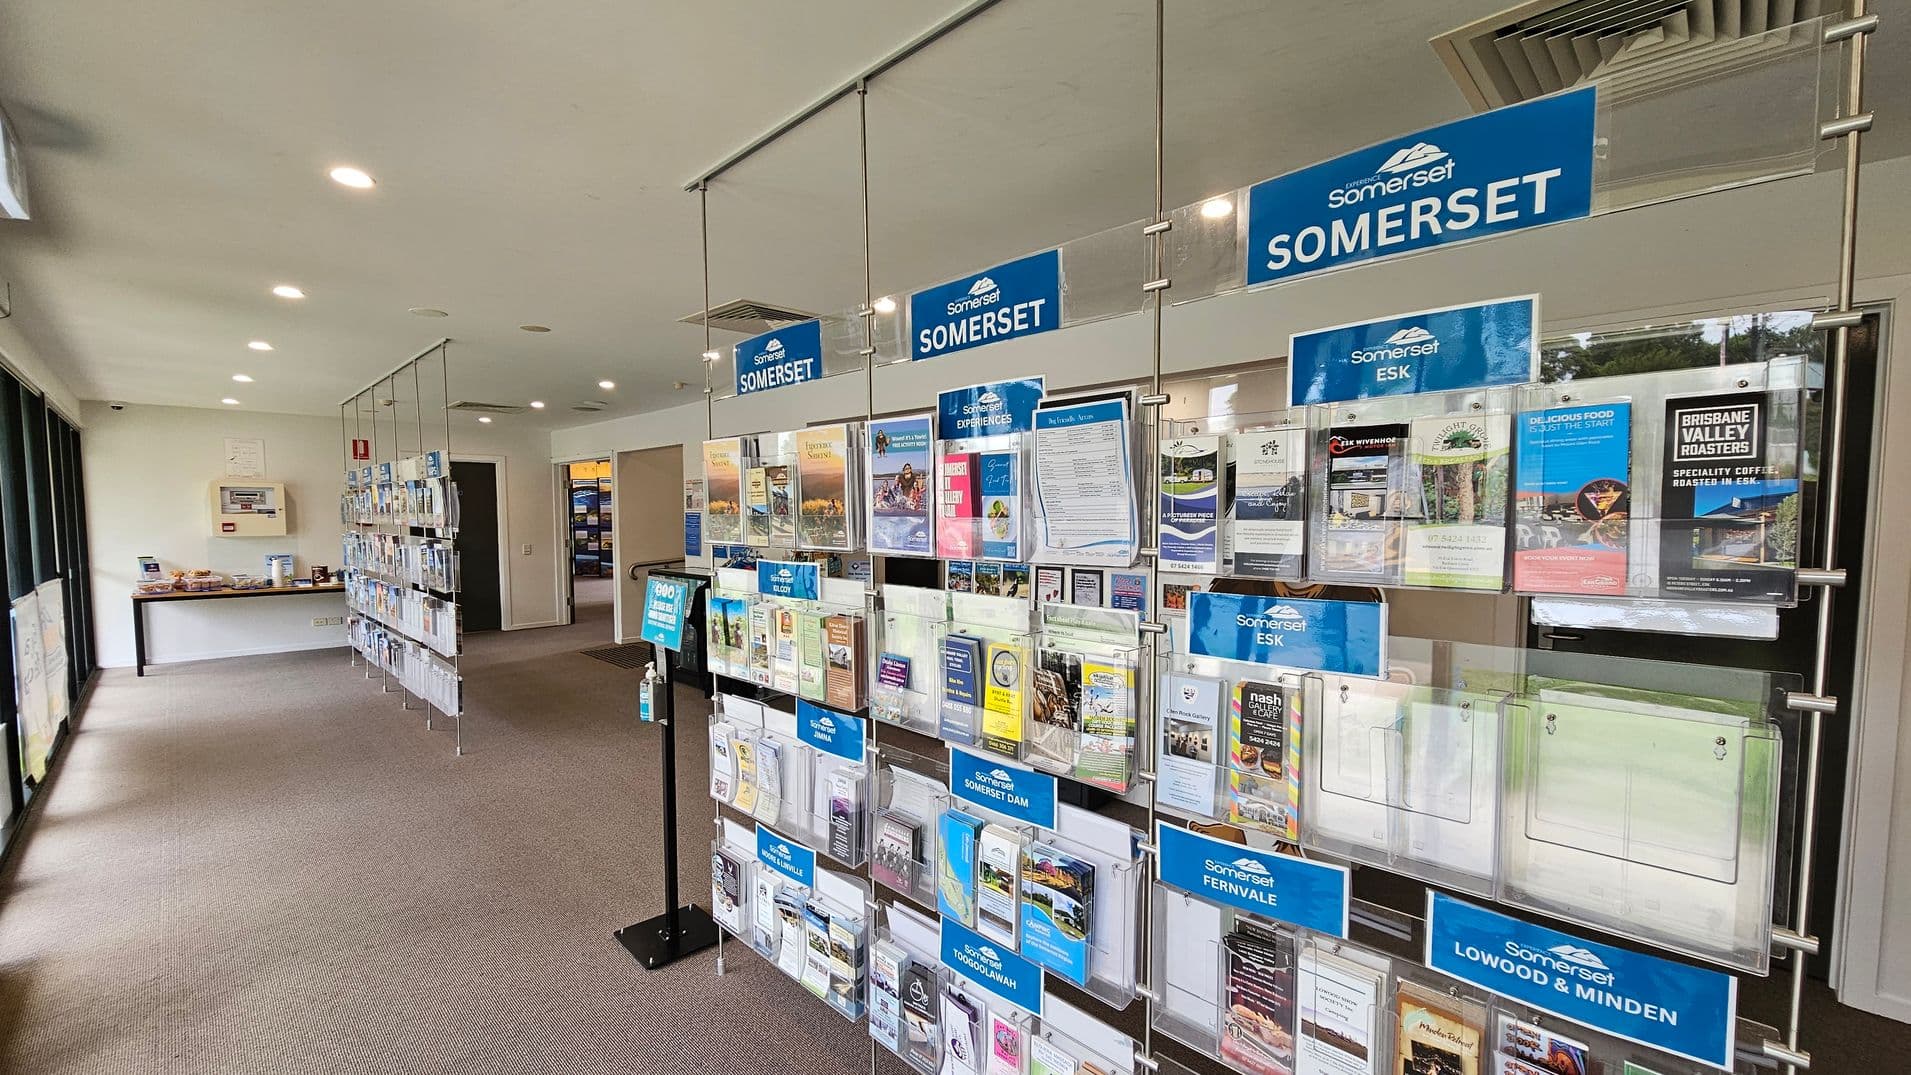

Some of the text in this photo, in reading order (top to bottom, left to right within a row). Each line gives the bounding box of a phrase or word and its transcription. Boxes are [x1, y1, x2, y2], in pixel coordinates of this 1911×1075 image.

[1328, 158, 1455, 208] Somerset
[1345, 173, 1382, 190] EXPERIENCE
[1266, 168, 1562, 271] SOMERSET
[946, 288, 1001, 315] Somerset
[919, 298, 1046, 353] SOMERSET
[754, 347, 786, 365] Somerset
[1351, 339, 1440, 364] Somerset
[740, 358, 814, 393] SOMERSET
[1376, 364, 1411, 381] ESK
[962, 400, 1003, 415] Somerset
[1583, 410, 1615, 419] FOOD
[956, 413, 1013, 430] EXPERIENCES
[1564, 421, 1584, 430] THE
[1584, 418, 1615, 429] START
[1681, 410, 1751, 427] BRISBANE
[1356, 437, 1397, 445] WIVENHOE
[1431, 421, 1466, 452] TWILIGHT
[1681, 424, 1750, 443] VALLEY
[1681, 441, 1750, 456] ROASTERS
[1673, 467, 1731, 478] SPECIALITY
[1672, 476, 1760, 488] ROASTED IN ESK.
[1441, 534, 1463, 543] 5424
[769, 574, 794, 584] Somerset
[773, 585, 792, 593] KILCOY
[1236, 614, 1308, 632] Somerset
[1256, 632, 1284, 647] ESK
[1248, 701, 1283, 714] GALLERY
[1250, 692, 1281, 706] nash
[1192, 711, 1211, 721] Gallery
[1257, 709, 1279, 720] CAFE
[809, 719, 836, 735] Somerset
[813, 731, 832, 743] JIMNA
[1248, 735, 1281, 748] 5424 2424
[975, 771, 1015, 792] Somerset
[964, 778, 1029, 808] SOMERSET DAM
[769, 844, 792, 861] Somerset
[761, 849, 777, 864] MOORE
[781, 859, 804, 877] LINVILLE
[1205, 859, 1275, 888] Somerset
[1203, 874, 1278, 907] FERNVALE
[964, 944, 1003, 971] Somerset
[1504, 940, 1615, 987] Somerset
[953, 947, 1017, 990] TOOGOOLAWAH
[1455, 941, 1678, 1026] LOWOOD & MINDEN
[1325, 1007, 1349, 1022] Camping
